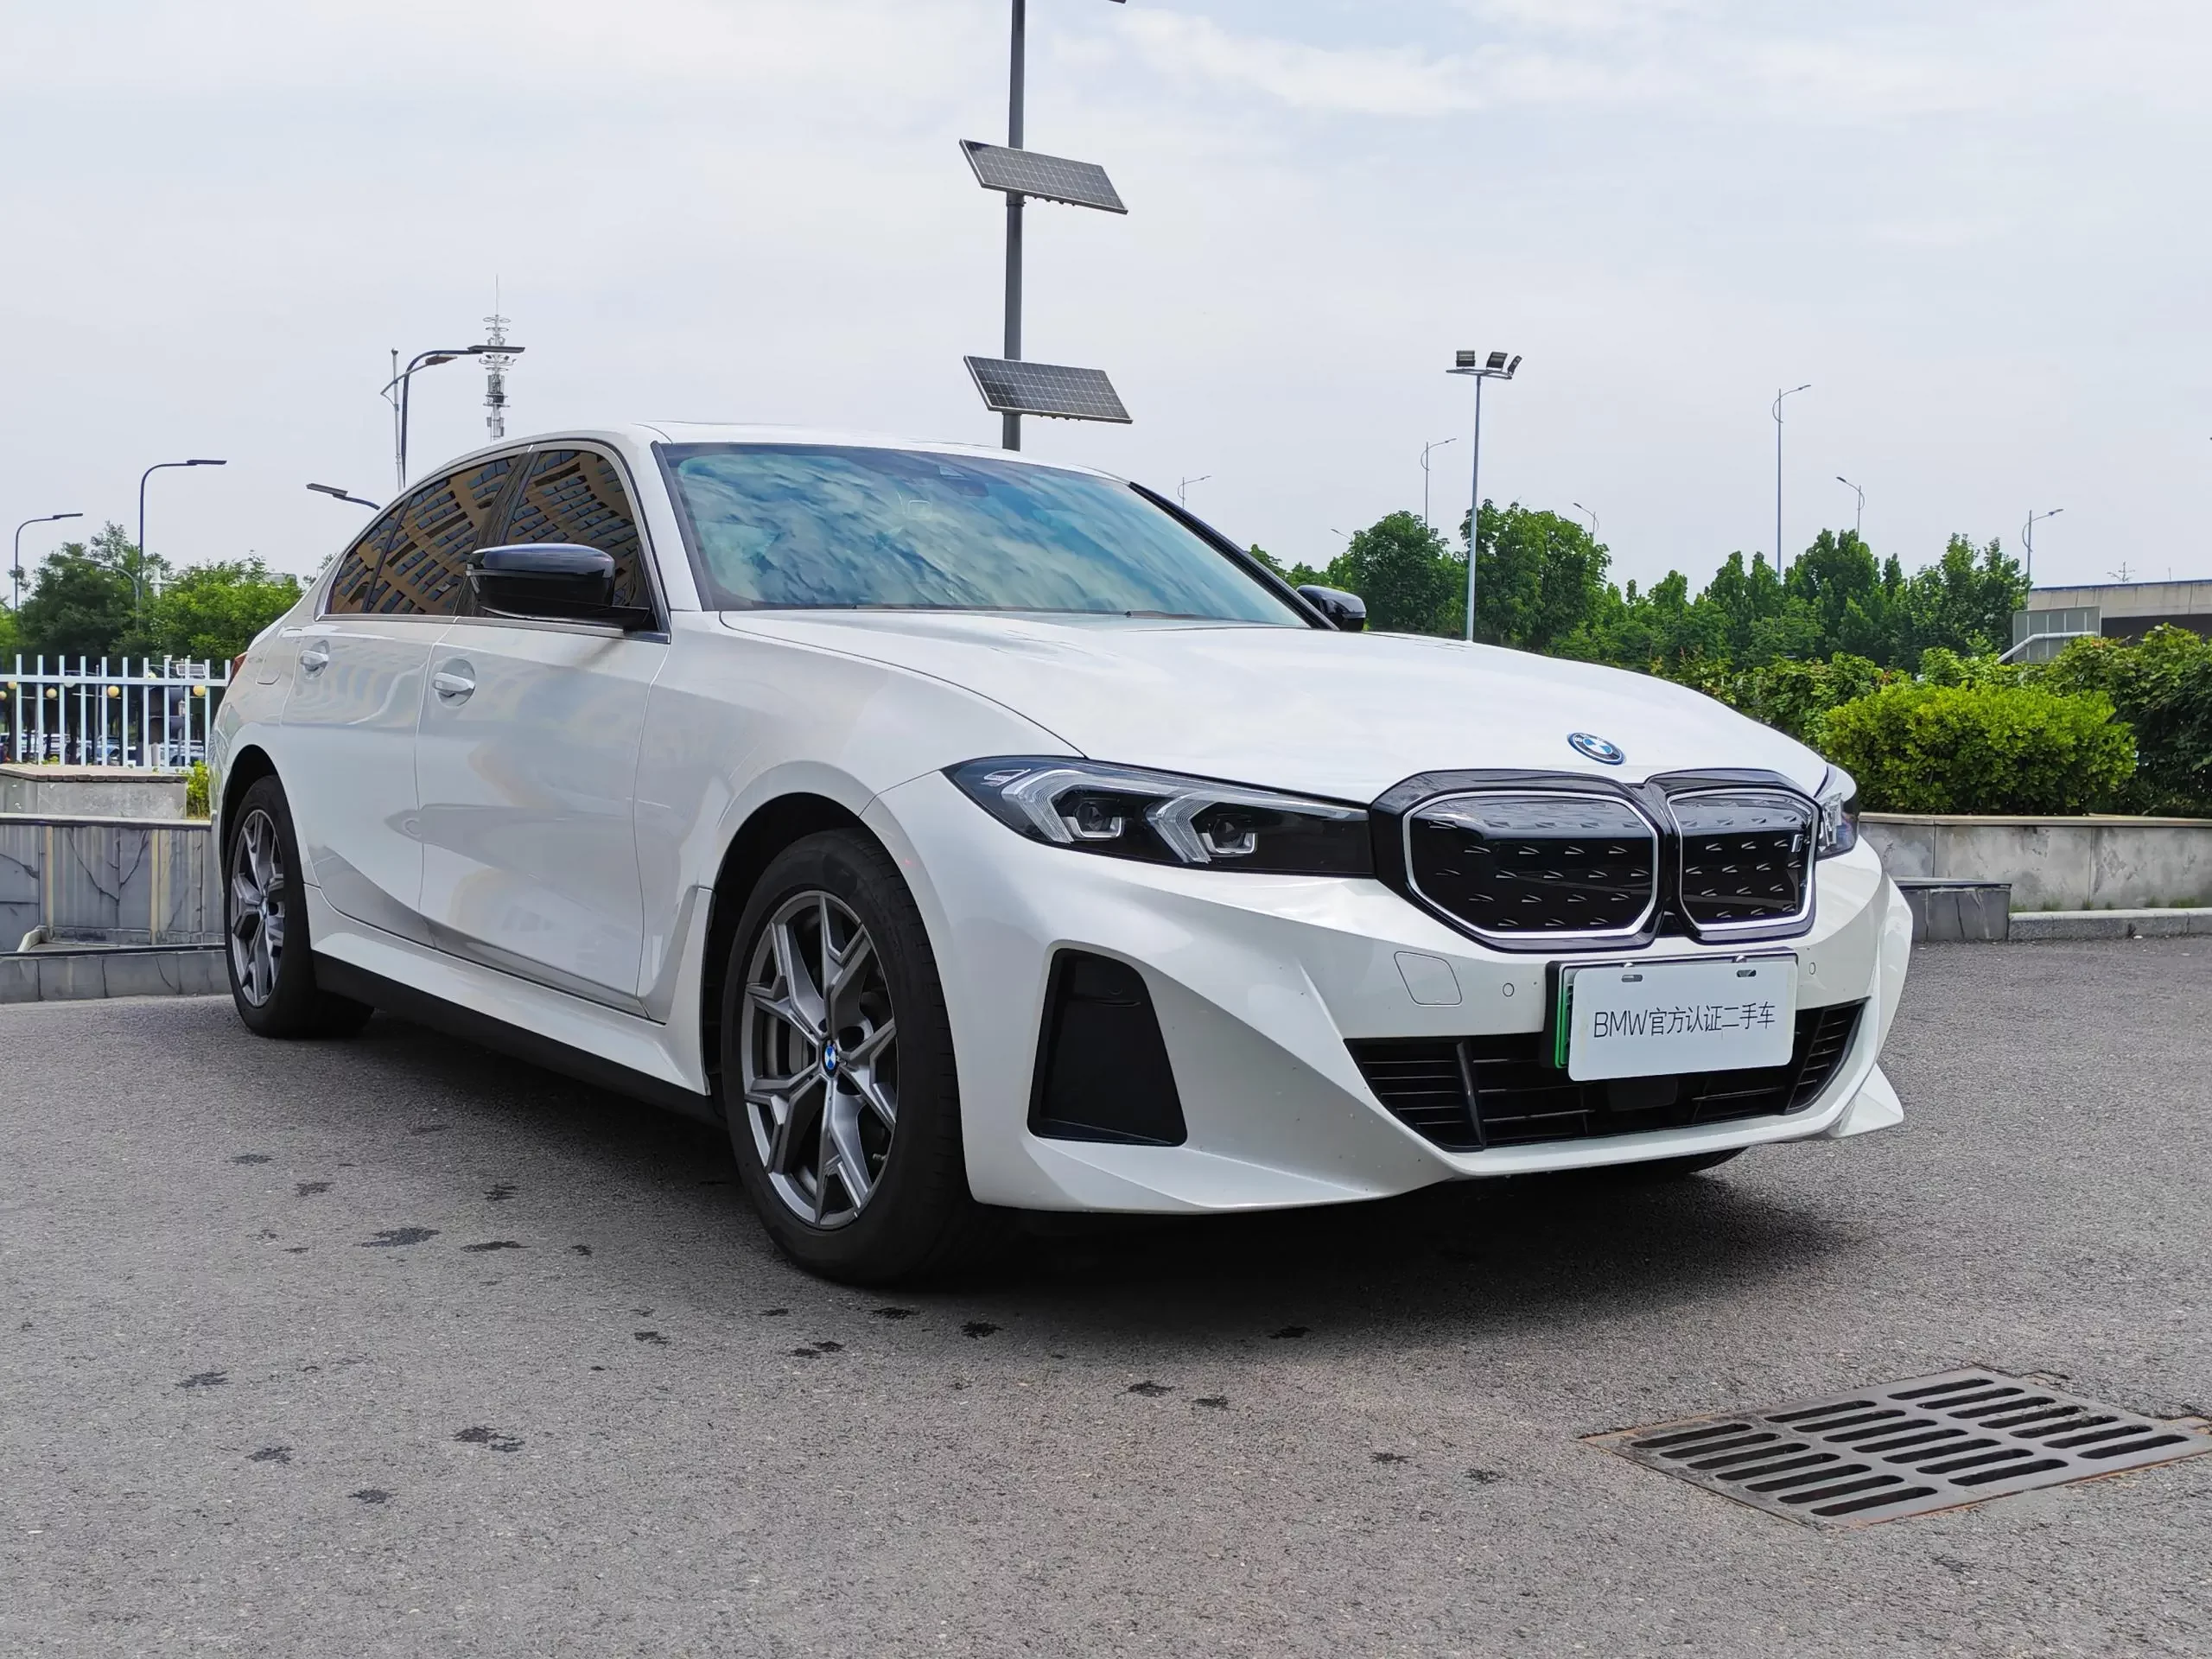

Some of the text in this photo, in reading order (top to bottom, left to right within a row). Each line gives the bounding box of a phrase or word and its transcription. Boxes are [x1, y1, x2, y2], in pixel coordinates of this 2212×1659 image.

[1593, 1001, 1776, 1038] BMW官方认证二手车
